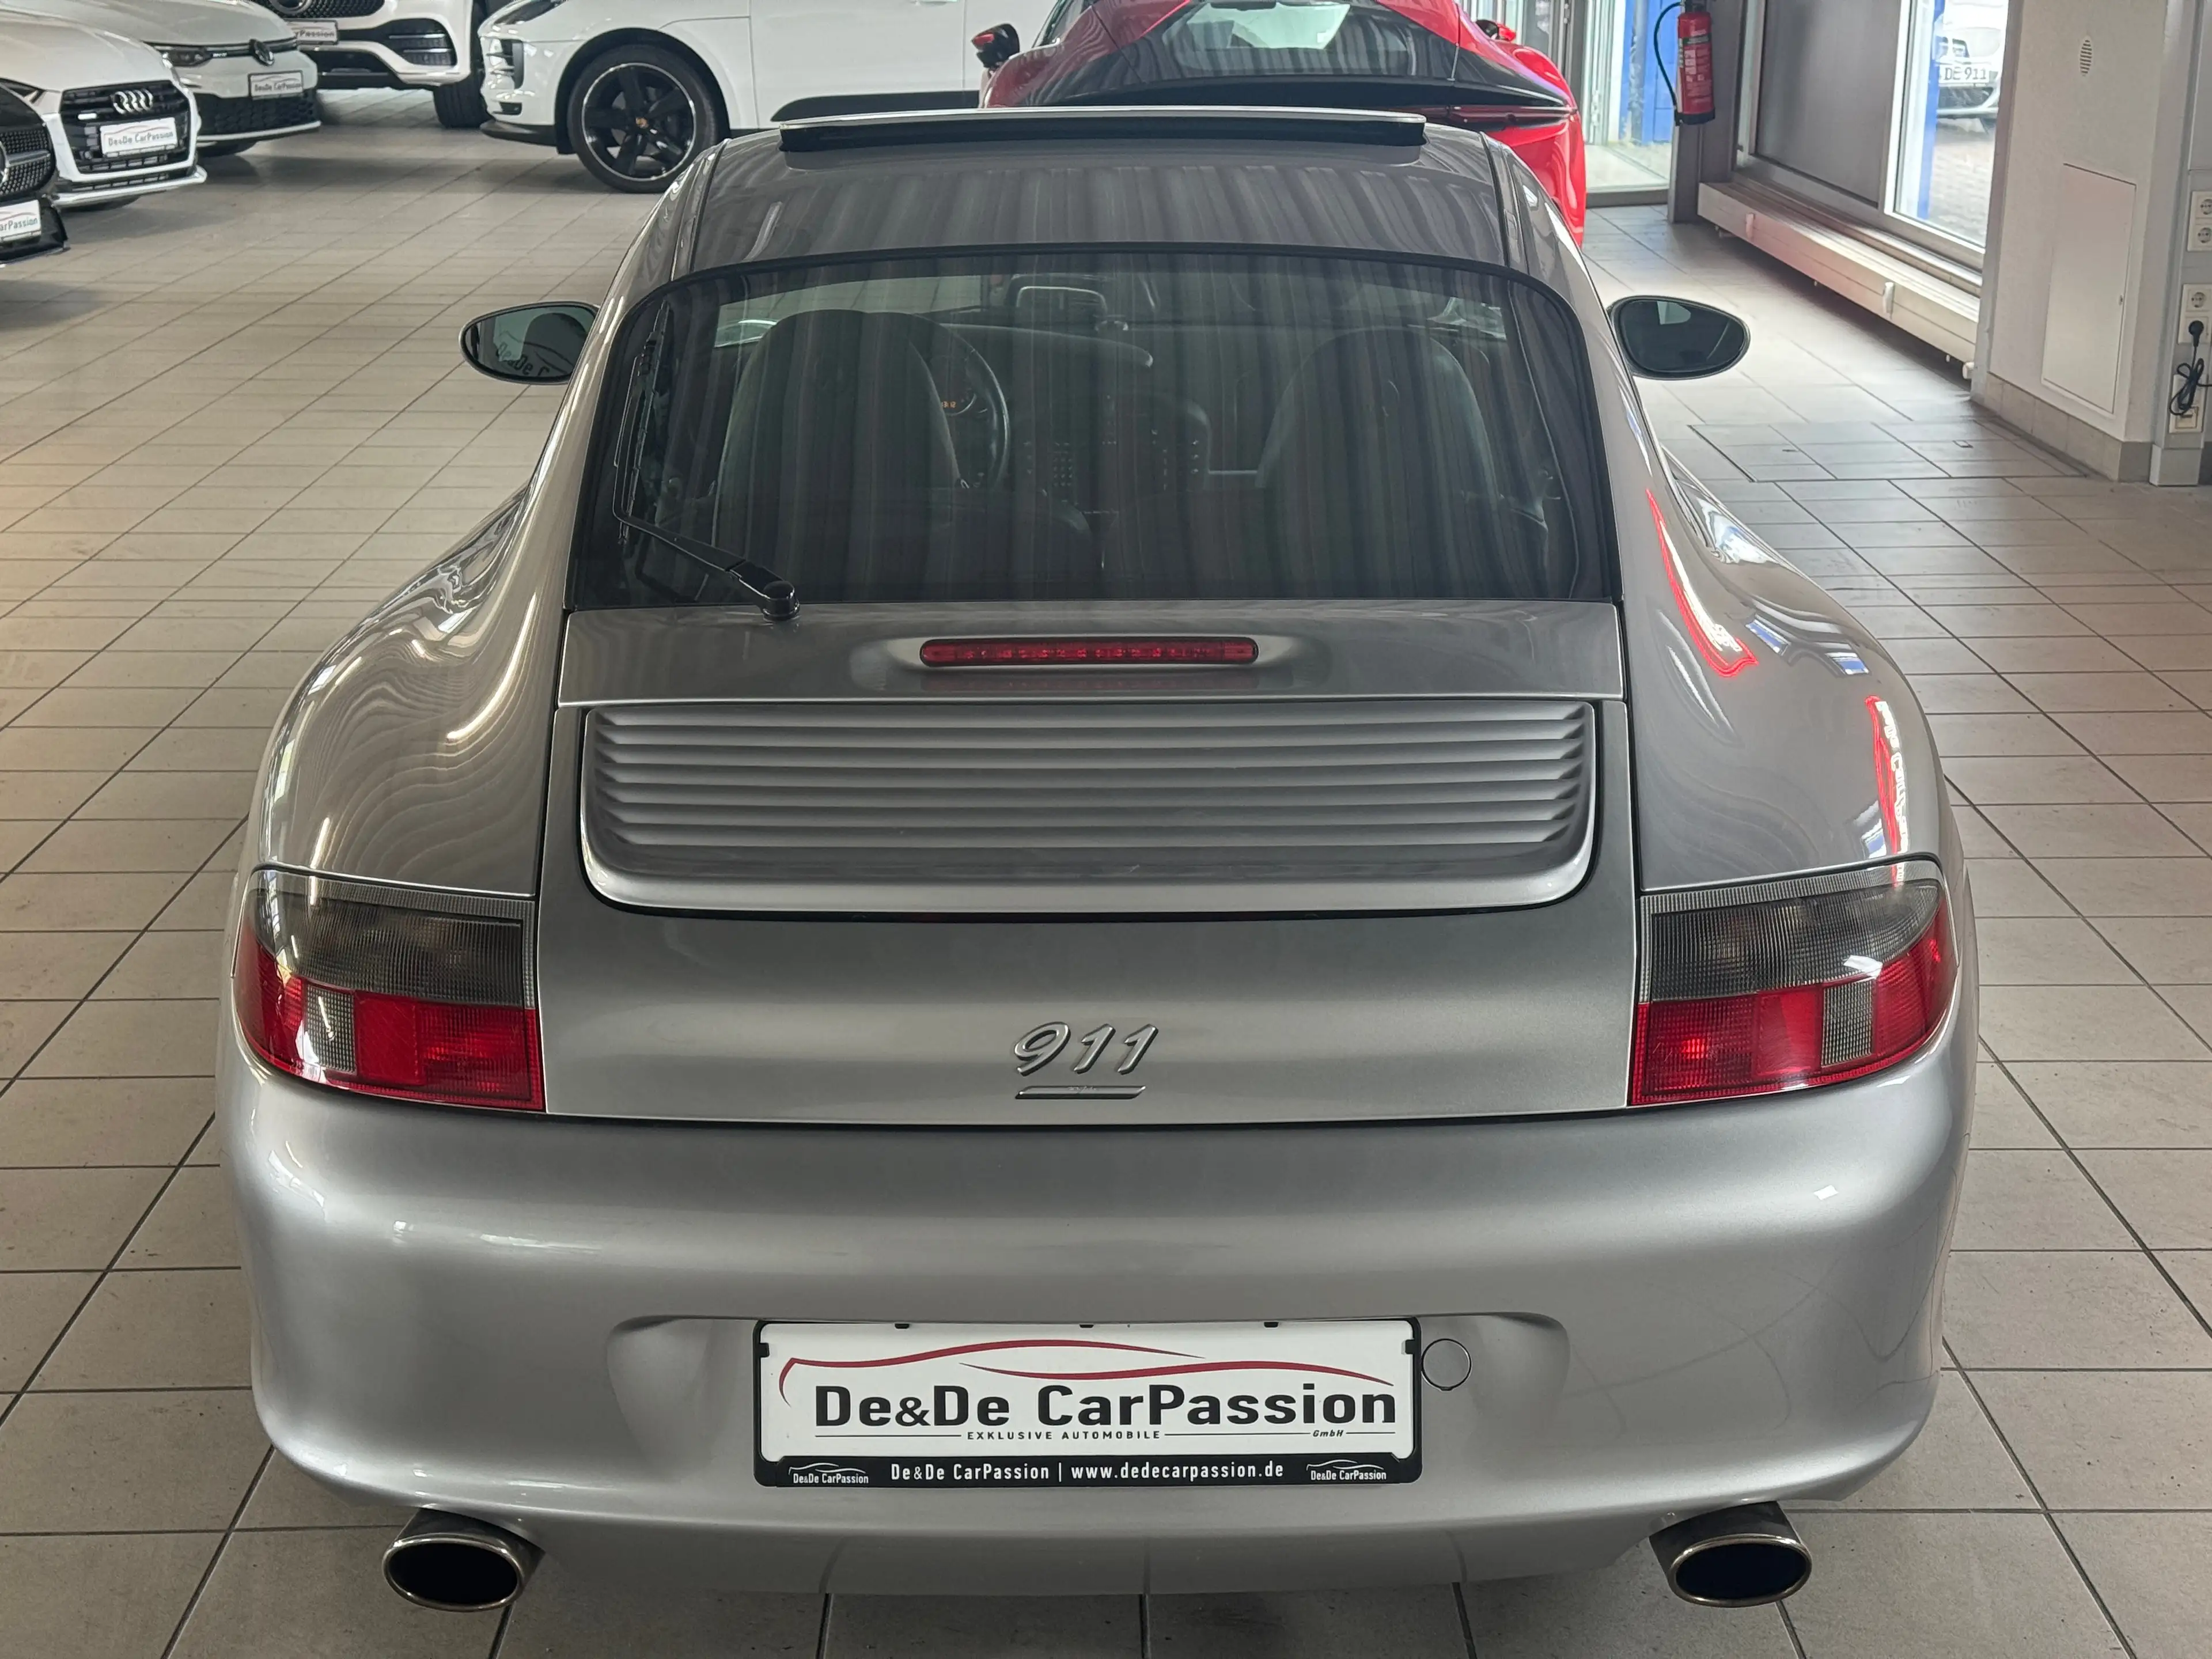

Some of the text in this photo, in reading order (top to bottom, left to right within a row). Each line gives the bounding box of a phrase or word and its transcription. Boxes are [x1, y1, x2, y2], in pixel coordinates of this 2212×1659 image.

[1964, 66, 1987, 80] 911
[0, 217, 38, 231] arPassion
[1014, 1021, 1159, 1077] 911
[816, 1383, 1396, 1427] De&De CarPassion
[967, 1431, 1052, 1441] EXKLUSIVE
[1062, 1431, 1160, 1440] AUTOMOBILE
[793, 1473, 869, 1484] De&De CarPassion
[891, 1463, 945, 1480] De&De
[953, 1463, 1049, 1480] CarPassion
[1071, 1461, 1283, 1483] www.dedecarpassion.de
[1310, 1469, 1387, 1480] De&De CarPassion
